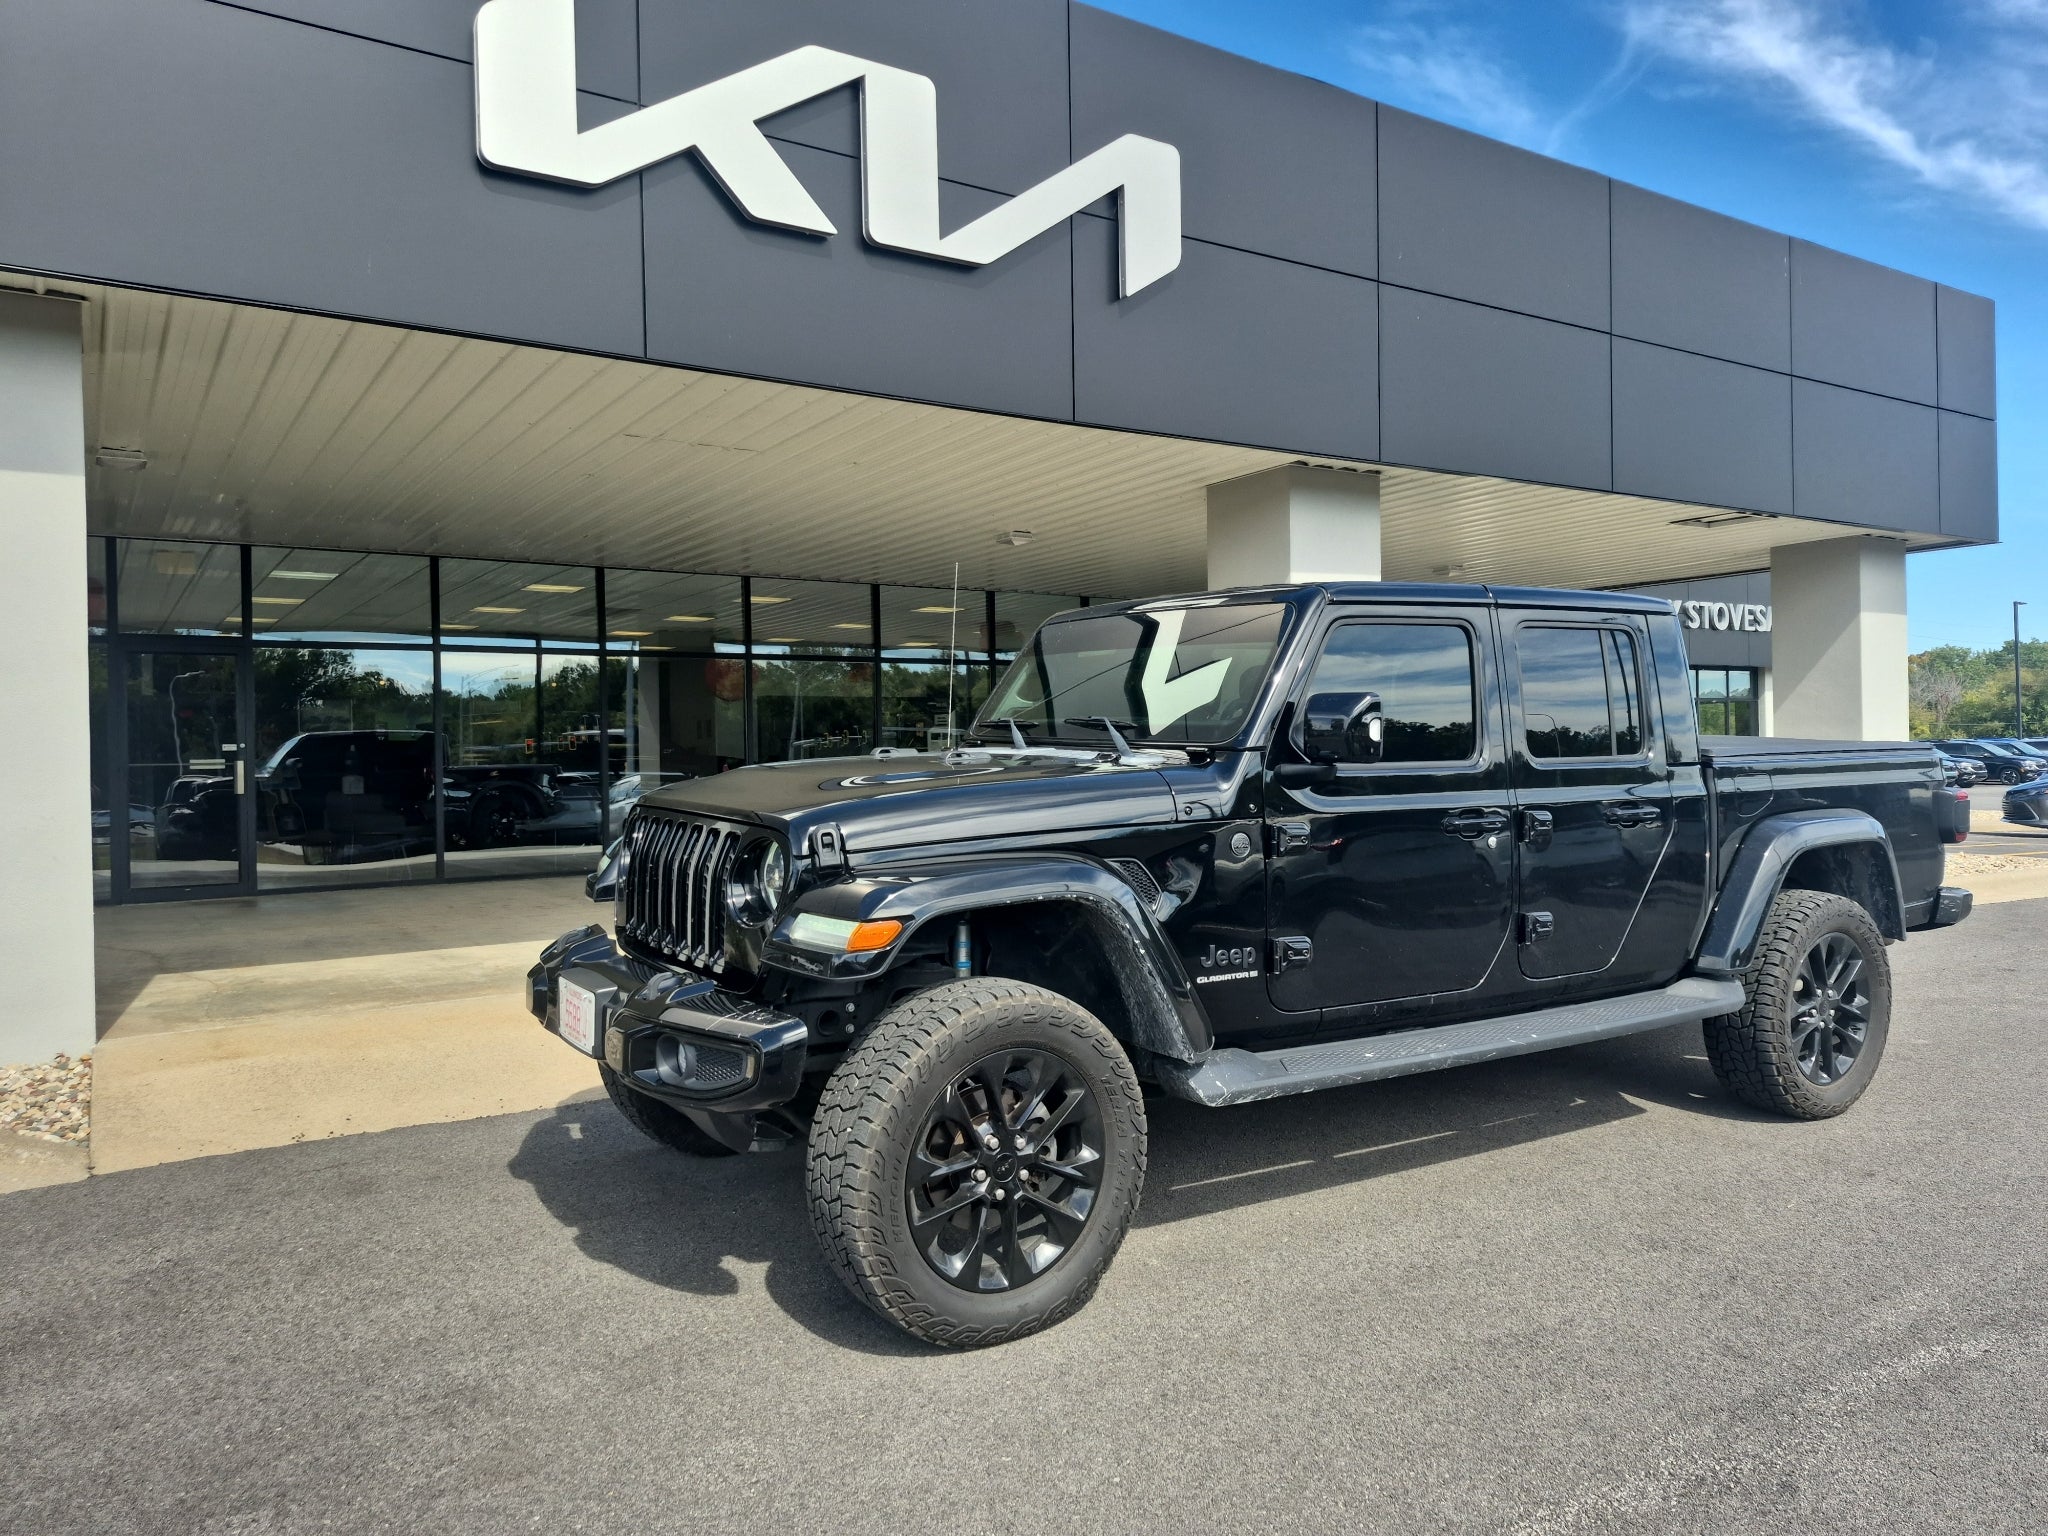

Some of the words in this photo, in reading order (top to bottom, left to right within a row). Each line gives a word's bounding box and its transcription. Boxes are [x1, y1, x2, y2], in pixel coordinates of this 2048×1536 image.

[473, 0, 1182, 298] KIA
[1200, 944, 1257, 969] Jeep
[1196, 971, 1250, 984] GLADIATOR
